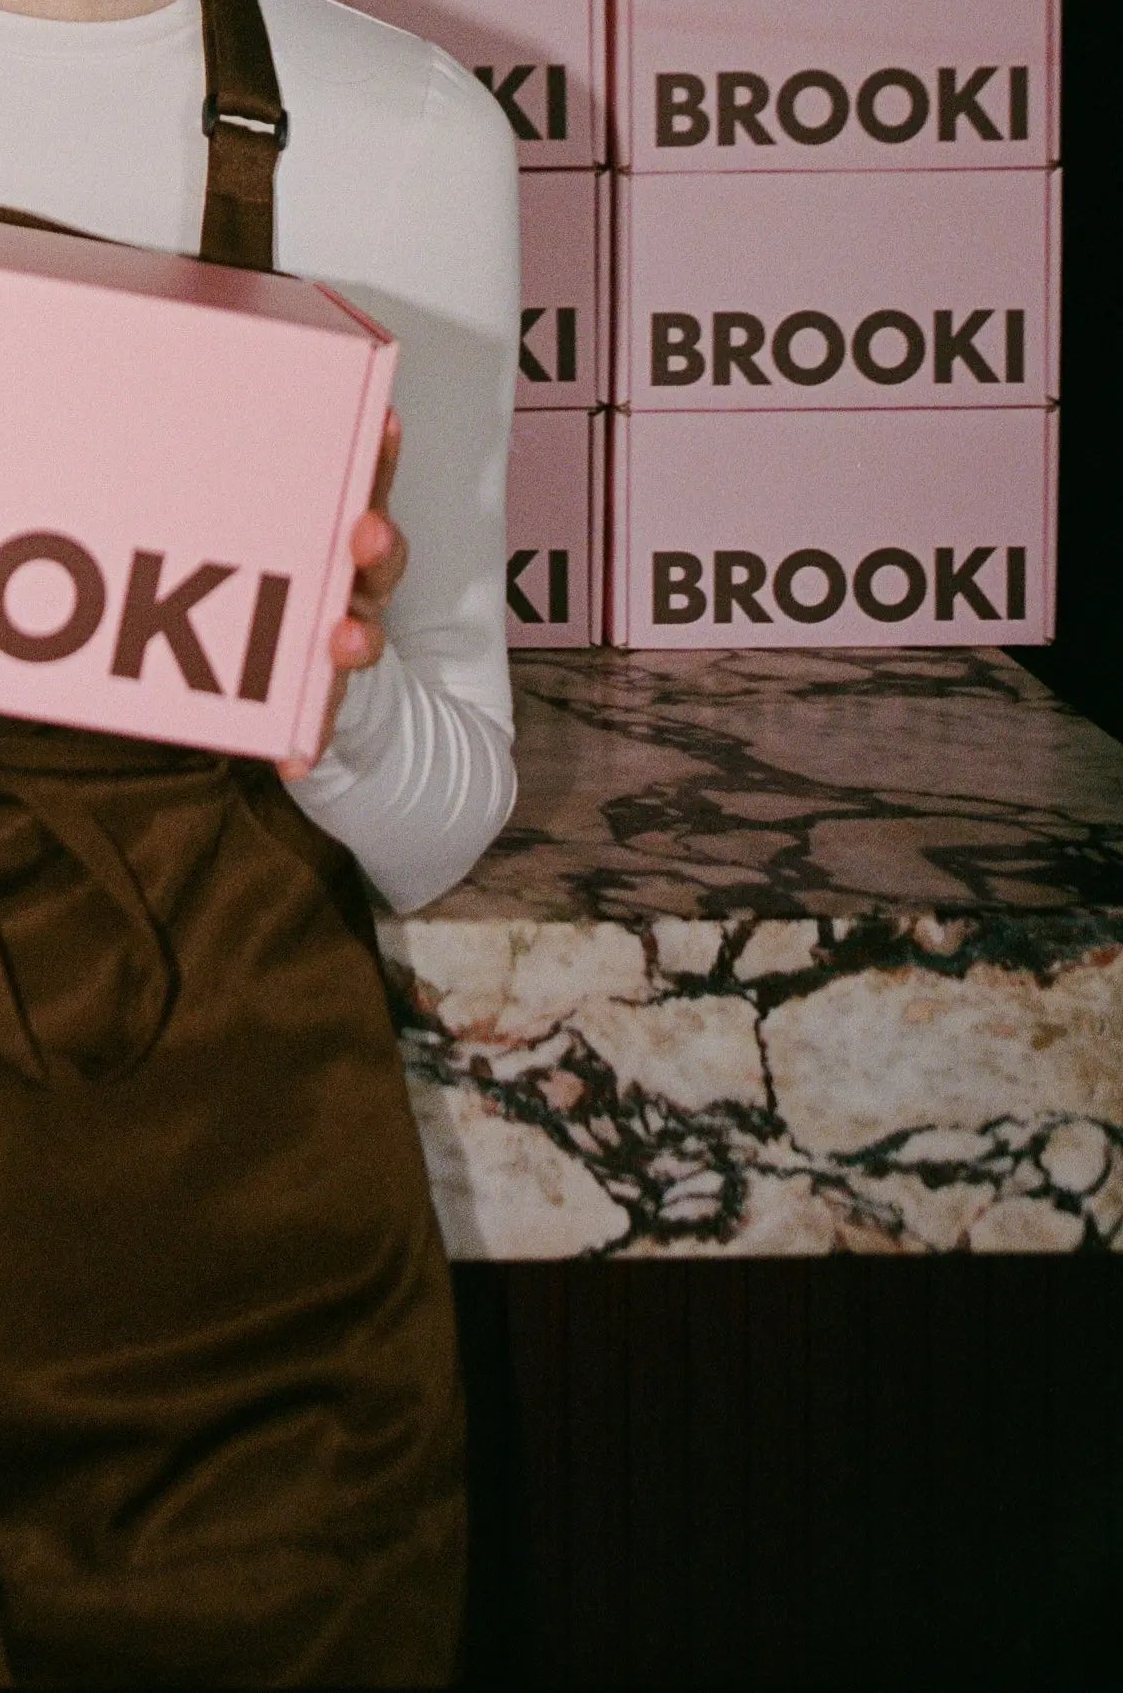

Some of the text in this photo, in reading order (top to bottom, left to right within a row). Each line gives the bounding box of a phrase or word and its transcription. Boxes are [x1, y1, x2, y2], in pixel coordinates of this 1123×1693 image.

[657, 66, 1028, 147] BROOKI
[652, 309, 1024, 385] BROOKI
[654, 547, 1026, 623] BROOKI
